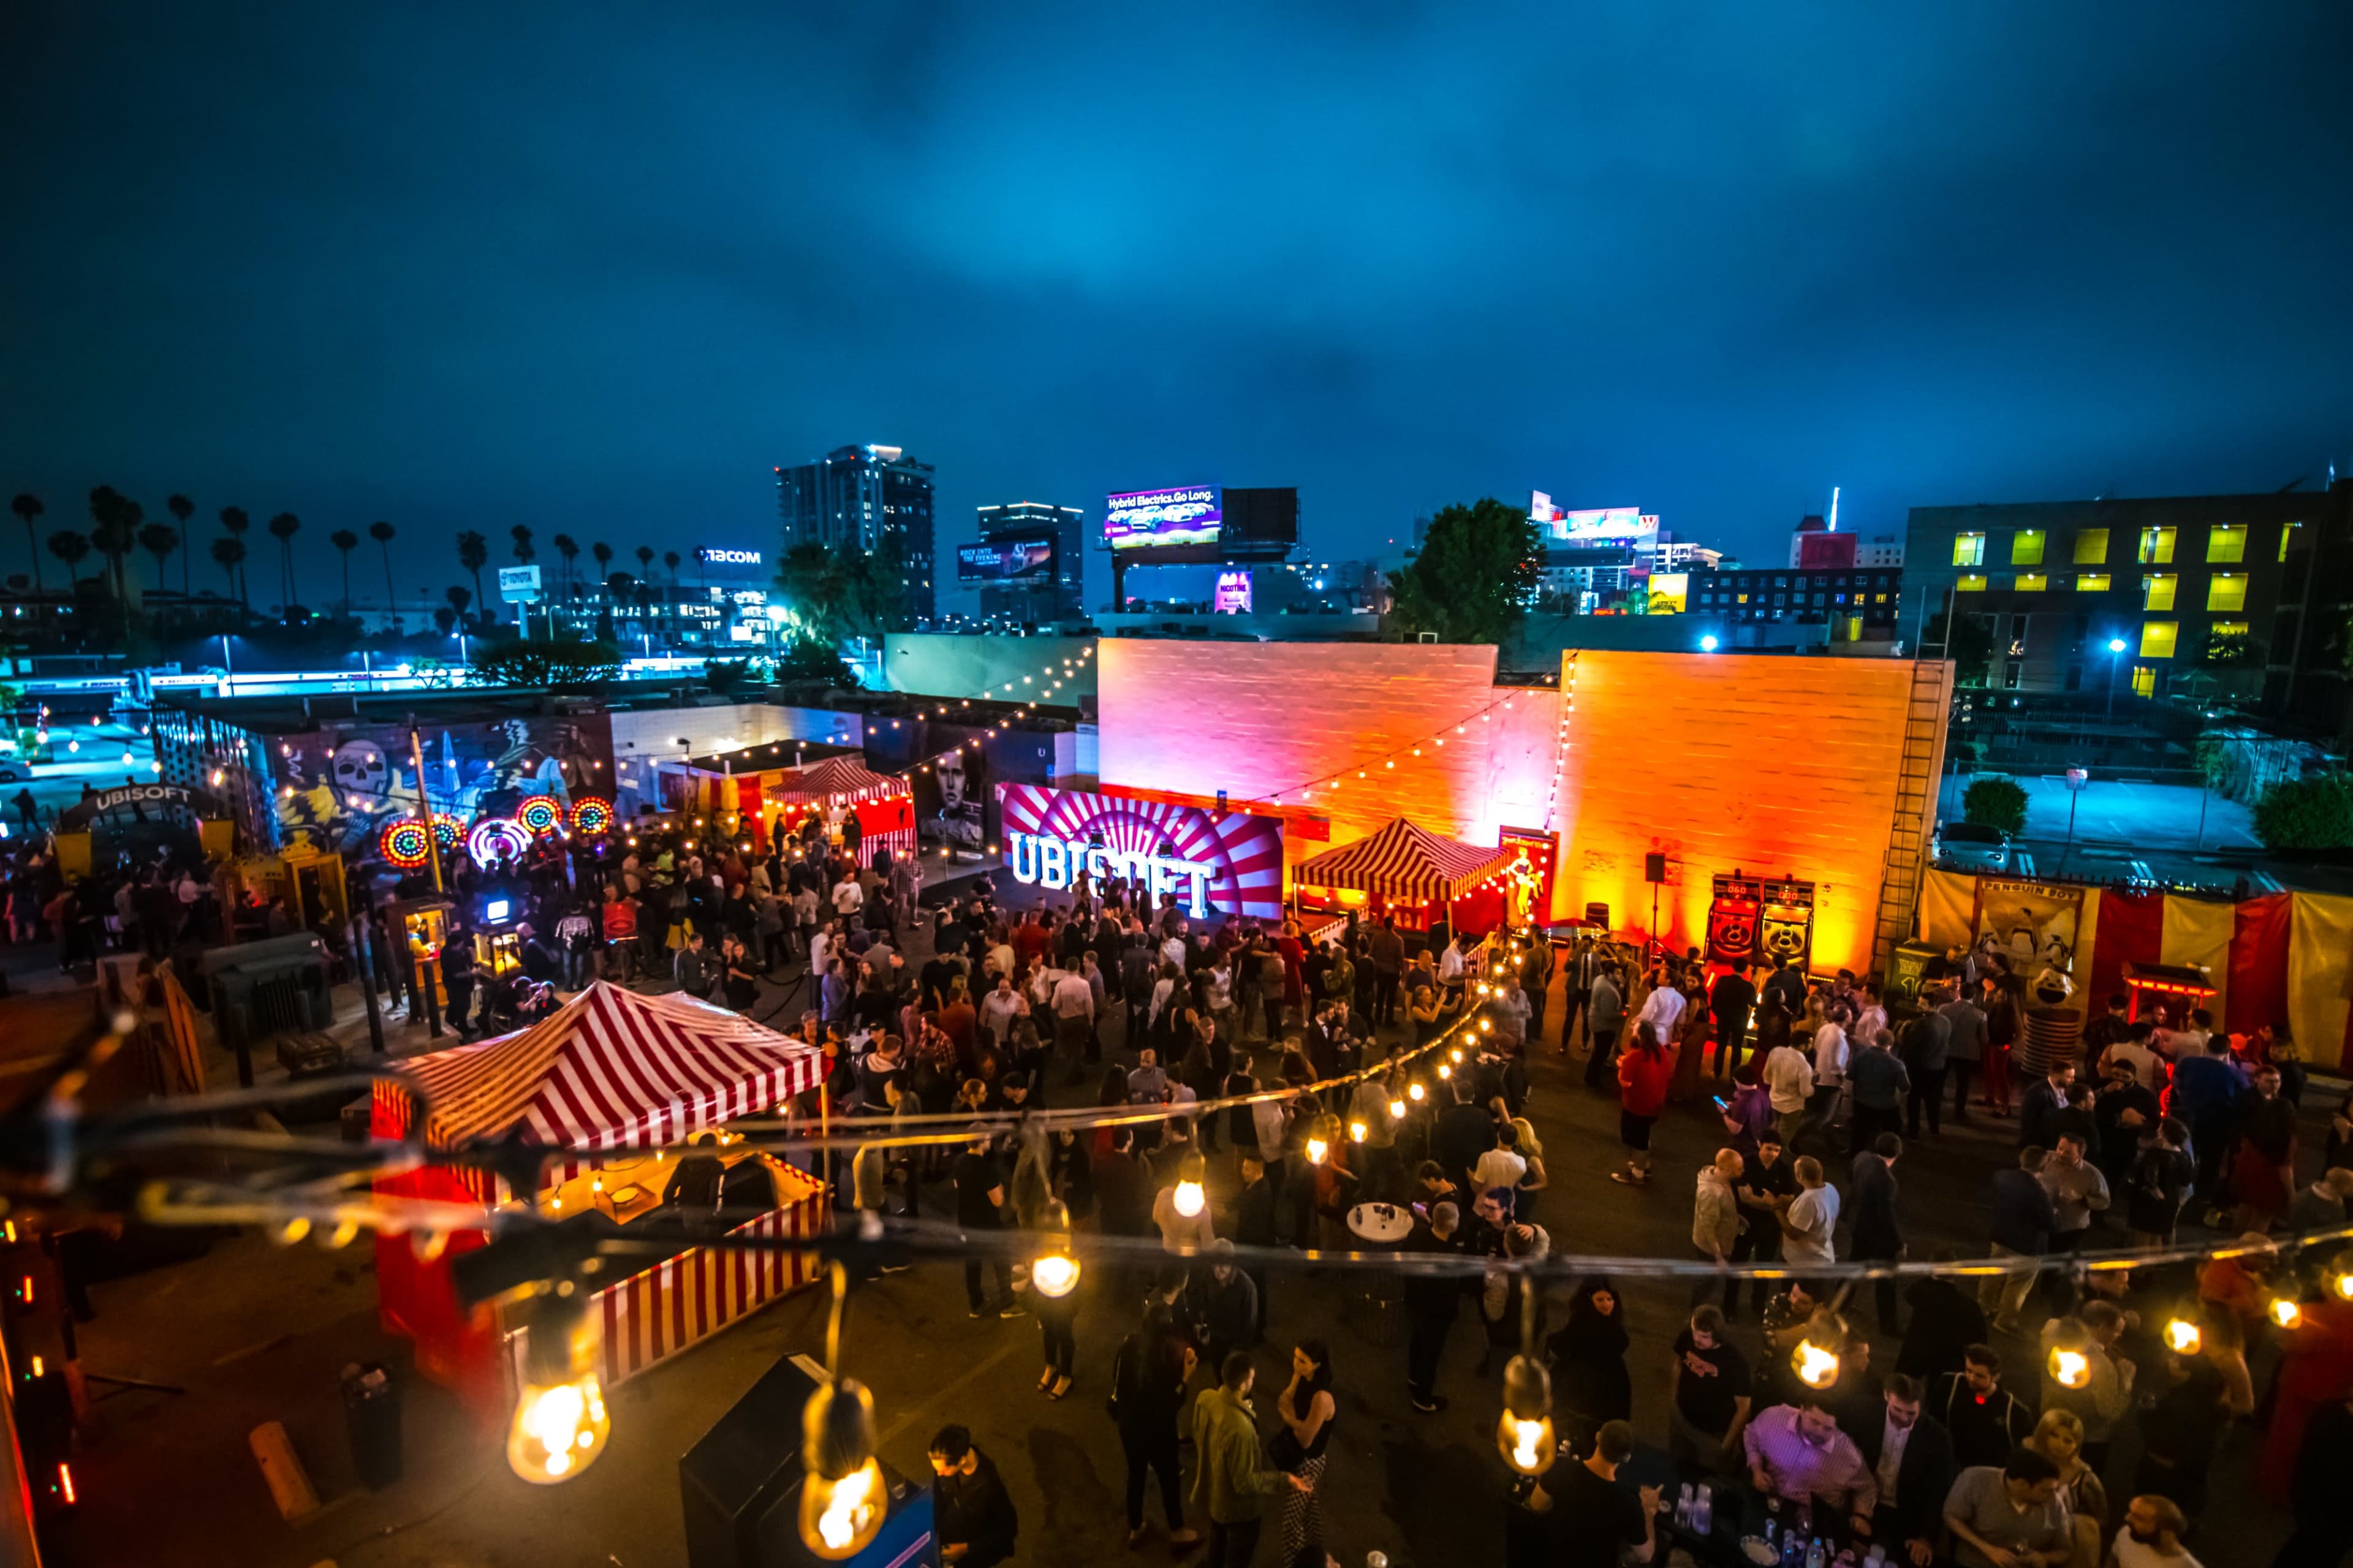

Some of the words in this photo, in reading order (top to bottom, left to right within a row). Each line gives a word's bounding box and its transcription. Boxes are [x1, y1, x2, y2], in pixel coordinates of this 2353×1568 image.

[1108, 496, 1136, 510] Hybrid
[1137, 493, 1174, 506] Electrics.
[1174, 491, 1187, 502] Go
[1189, 490, 1214, 502] Long.
[508, 572, 532, 584] TOYOTA
[97, 786, 191, 811] UBISOFT
[1727, 885, 1746, 895] 060
[1984, 882, 2045, 895] PENGUIN
[2049, 889, 2075, 900] BOY
